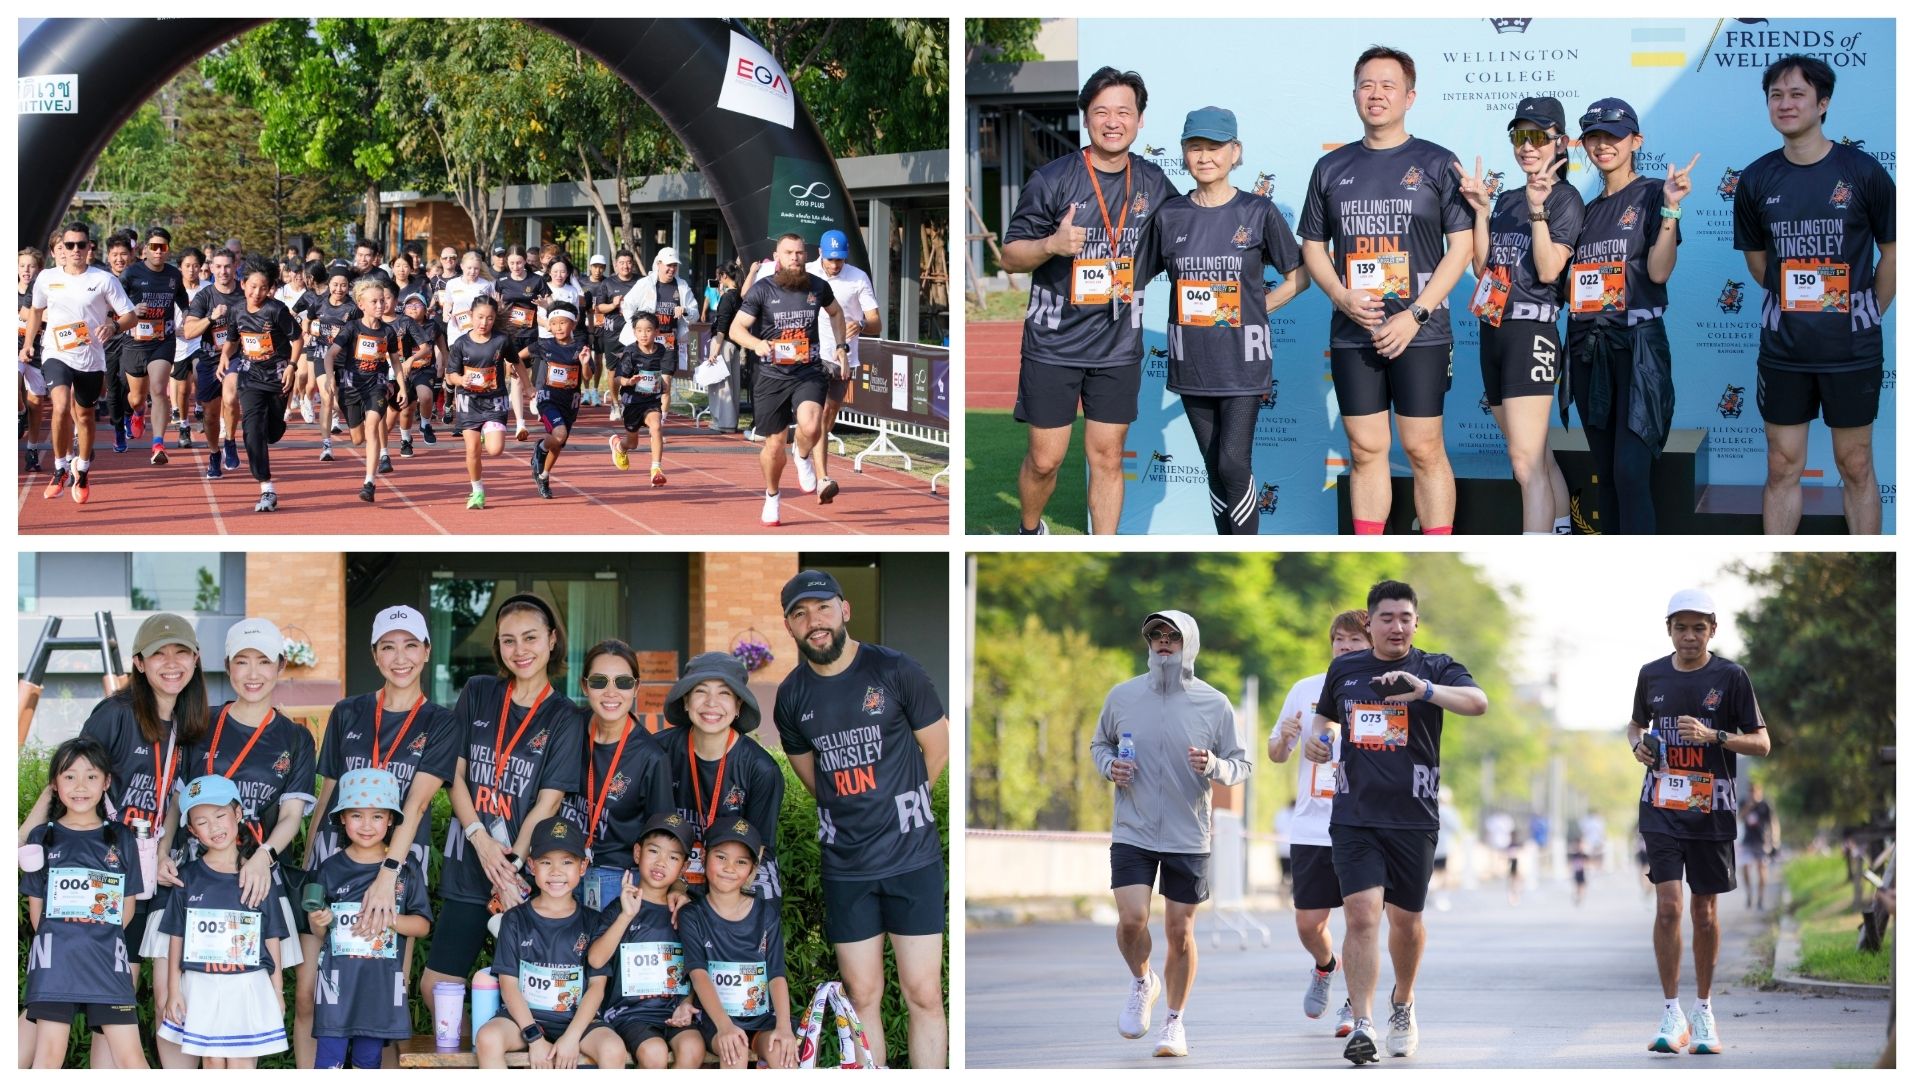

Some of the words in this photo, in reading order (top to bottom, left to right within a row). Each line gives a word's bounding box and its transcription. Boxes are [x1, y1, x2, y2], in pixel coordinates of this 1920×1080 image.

[1726, 30, 1835, 48] FRIENDS
[1840, 32, 1862, 51] of
[1443, 49, 1579, 63] WELLINGTON
[1715, 52, 1868, 68] WELLTON
[737, 57, 787, 94] EGA
[1465, 70, 1556, 83] COLLEGE
[18, 78, 71, 98] ติเวช
[1486, 103, 1518, 111] BANG
[1339, 176, 1355, 186] Ari
[795, 199, 809, 207] 289
[810, 201, 825, 209] PLUS
[1766, 195, 1780, 205] Ari
[1340, 199, 1413, 216] WELLINGTON
[1696, 209, 1734, 217] WELLIN
[1341, 215, 1413, 236] KINGSLEY
[1771, 218, 1843, 237] WELLINGTON
[1774, 235, 1843, 257] KINGSLEY
[1175, 256, 1243, 271] WELLINGTON
[1357, 263, 1376, 274] 139
[1083, 269, 1104, 280] 104
[1580, 274, 1598, 285] 022
[1793, 274, 1816, 285] 150
[1187, 290, 1211, 301] 040
[145, 299, 171, 308] INGSLEY
[773, 309, 815, 320] WELLINGTON
[59, 329, 72, 338] 026
[362, 340, 375, 348] 028
[780, 344, 790, 352] 116
[1531, 334, 1556, 382] 247
[1154, 465, 1200, 475] FRIENDS
[1149, 474, 1209, 484] WELLINGTO
[390, 610, 408, 620] alo
[801, 710, 814, 722] Ari
[1360, 713, 1382, 723] 073
[346, 731, 362, 740] Ari
[812, 725, 882, 751] WELLINGTON
[134, 747, 149, 755] Ari
[203, 752, 219, 760] Ai
[820, 741, 883, 772] KINGSLEY
[470, 744, 535, 778] WELLGTON
[1668, 747, 1704, 768] RUN
[834, 765, 877, 797] RUN
[1668, 777, 1684, 788] 151
[48, 851, 61, 859] Ari
[60, 878, 90, 890] 006
[337, 885, 350, 894] Ari
[188, 894, 203, 902] Ari
[340, 914, 358, 925] 00
[197, 920, 226, 933] 003
[633, 954, 659, 967] 018
[528, 976, 551, 990] 019
[715, 973, 742, 986] 002
